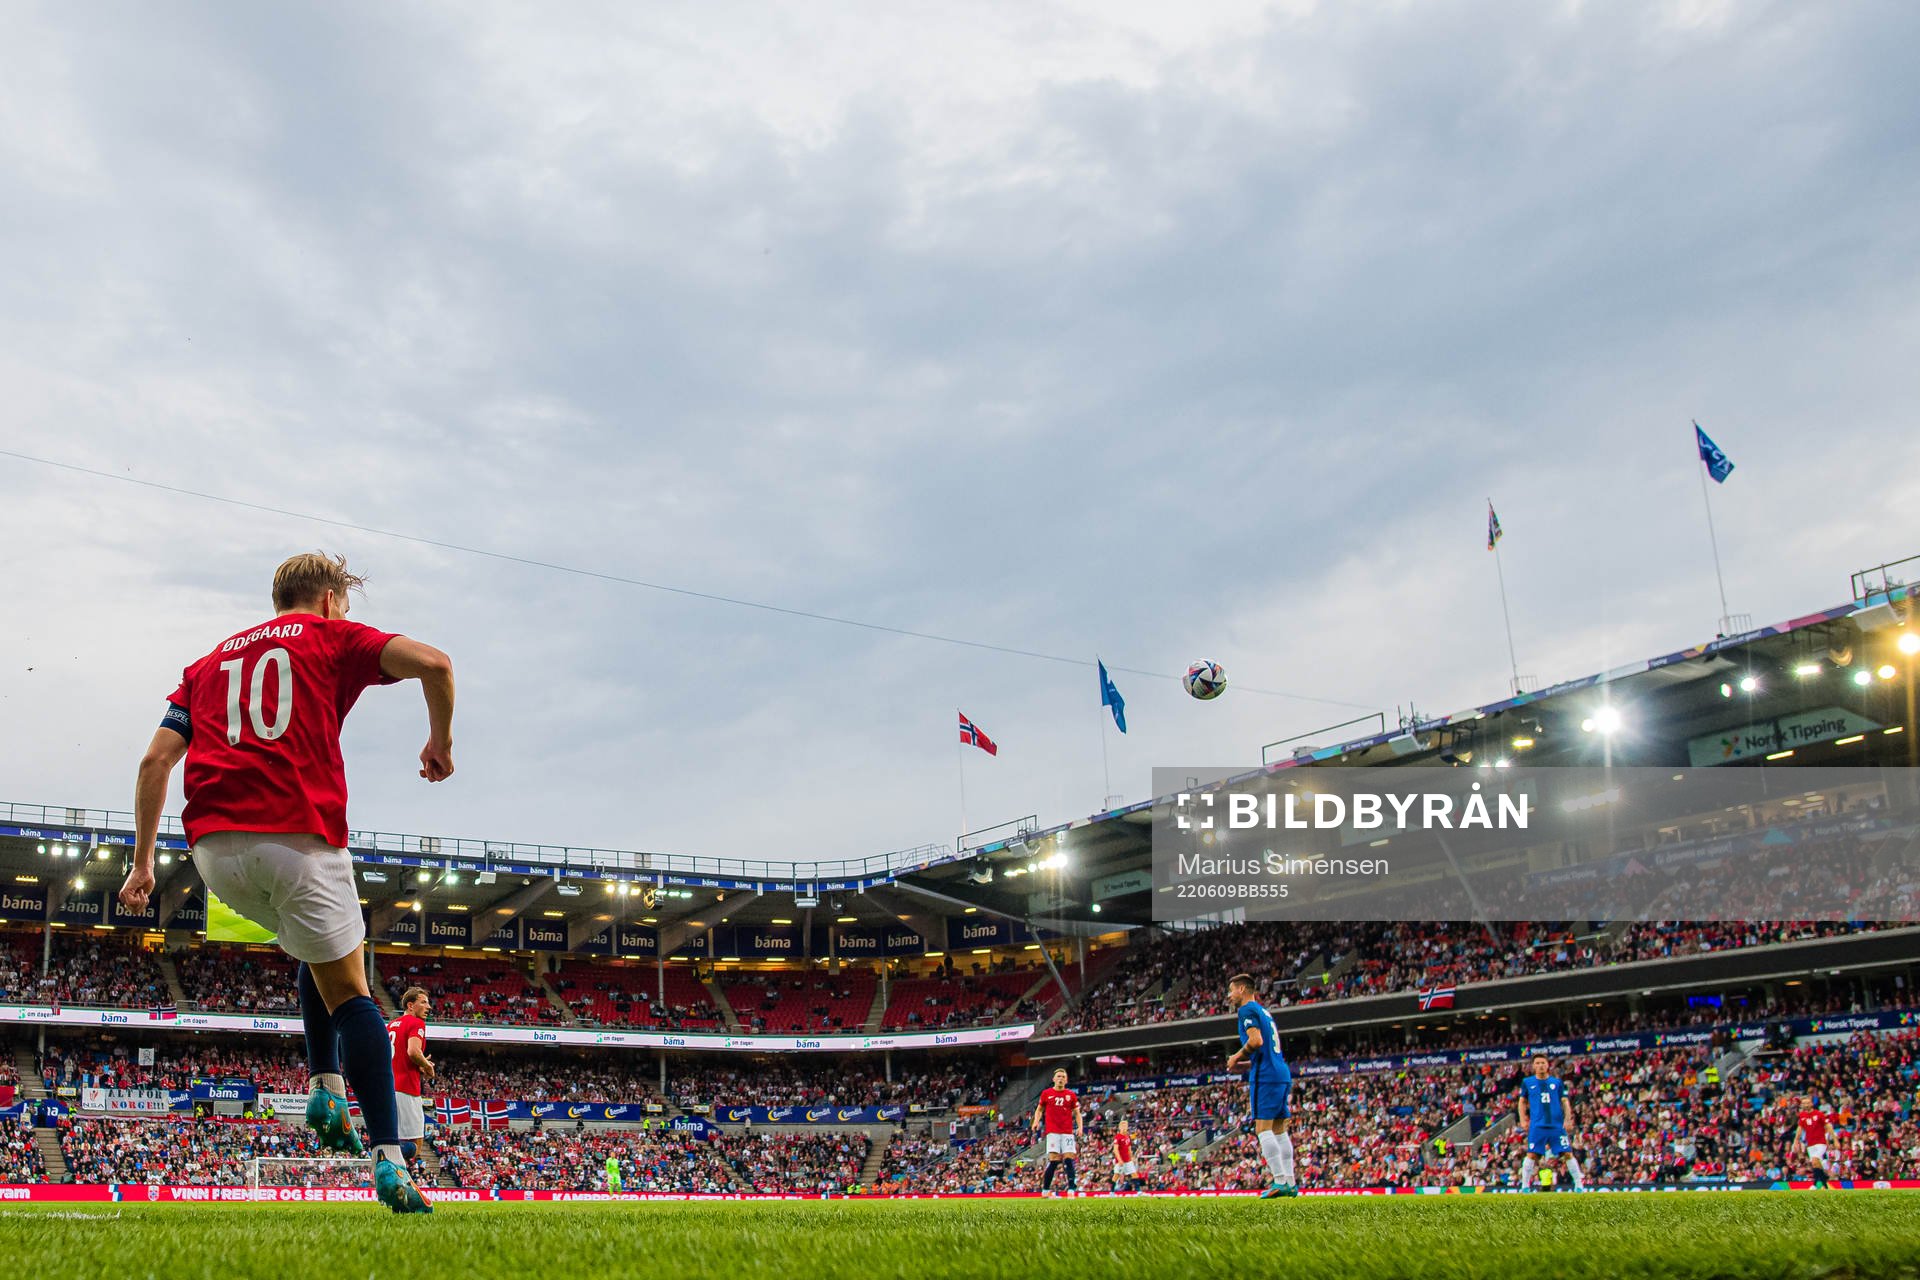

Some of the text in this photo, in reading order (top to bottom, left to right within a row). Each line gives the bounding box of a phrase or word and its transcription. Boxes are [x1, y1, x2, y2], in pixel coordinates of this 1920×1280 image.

[221, 623, 303, 652] ØDEGAARD
[220, 648, 293, 746] 10
[167, 710, 190, 723] RESPEC
[1790, 718, 1846, 740] Tipping
[20, 828, 41, 838] bama
[63, 832, 84, 841] bama
[105, 835, 126, 844] bama
[383, 855, 402, 864] bama
[420, 858, 439, 867] bama
[457, 861, 476, 870] bama
[494, 864, 512, 873] bama
[530, 867, 548, 875] bama
[634, 874, 652, 882] bama
[668, 876, 686, 884] bama
[702, 878, 719, 887] bama
[735, 881, 752, 889] bama
[776, 883, 794, 891] bama
[826, 882, 845, 890] bama
[2, 895, 43, 911] bama
[431, 922, 467, 937] bama
[529, 927, 563, 942] bama
[963, 924, 997, 939] bama
[622, 933, 655, 948] bama
[755, 936, 791, 949] bama
[840, 935, 877, 949] bama
[888, 935, 919, 948] bama
[37, 1011, 53, 1019] dagen
[101, 1013, 128, 1023] bama
[192, 1017, 208, 1025] dagen
[253, 1019, 279, 1029] bama
[1824, 1017, 1880, 1029] Norsk Tipping
[534, 1031, 557, 1041] bama
[1742, 1027, 1766, 1037] Norsk
[663, 1036, 685, 1046] bama
[796, 1039, 820, 1048] bama
[936, 1034, 958, 1044] bama
[1596, 1038, 1640, 1049] Norsk Tipping
[1469, 1051, 1508, 1060] Norsk Tipping
[108, 1090, 162, 1099] ALT FOR
[208, 1087, 239, 1099] bama
[111, 1101, 164, 1110] NORGE!!!
[1055, 1097, 1064, 1106] 22
[674, 1119, 703, 1131] bama
[171, 1187, 209, 1200] VINN
[212, 1188, 279, 1200] PREMIER
[280, 1189, 302, 1201] OG
[305, 1189, 324, 1201] SE
[421, 1191, 480, 1201] NNHOLD
